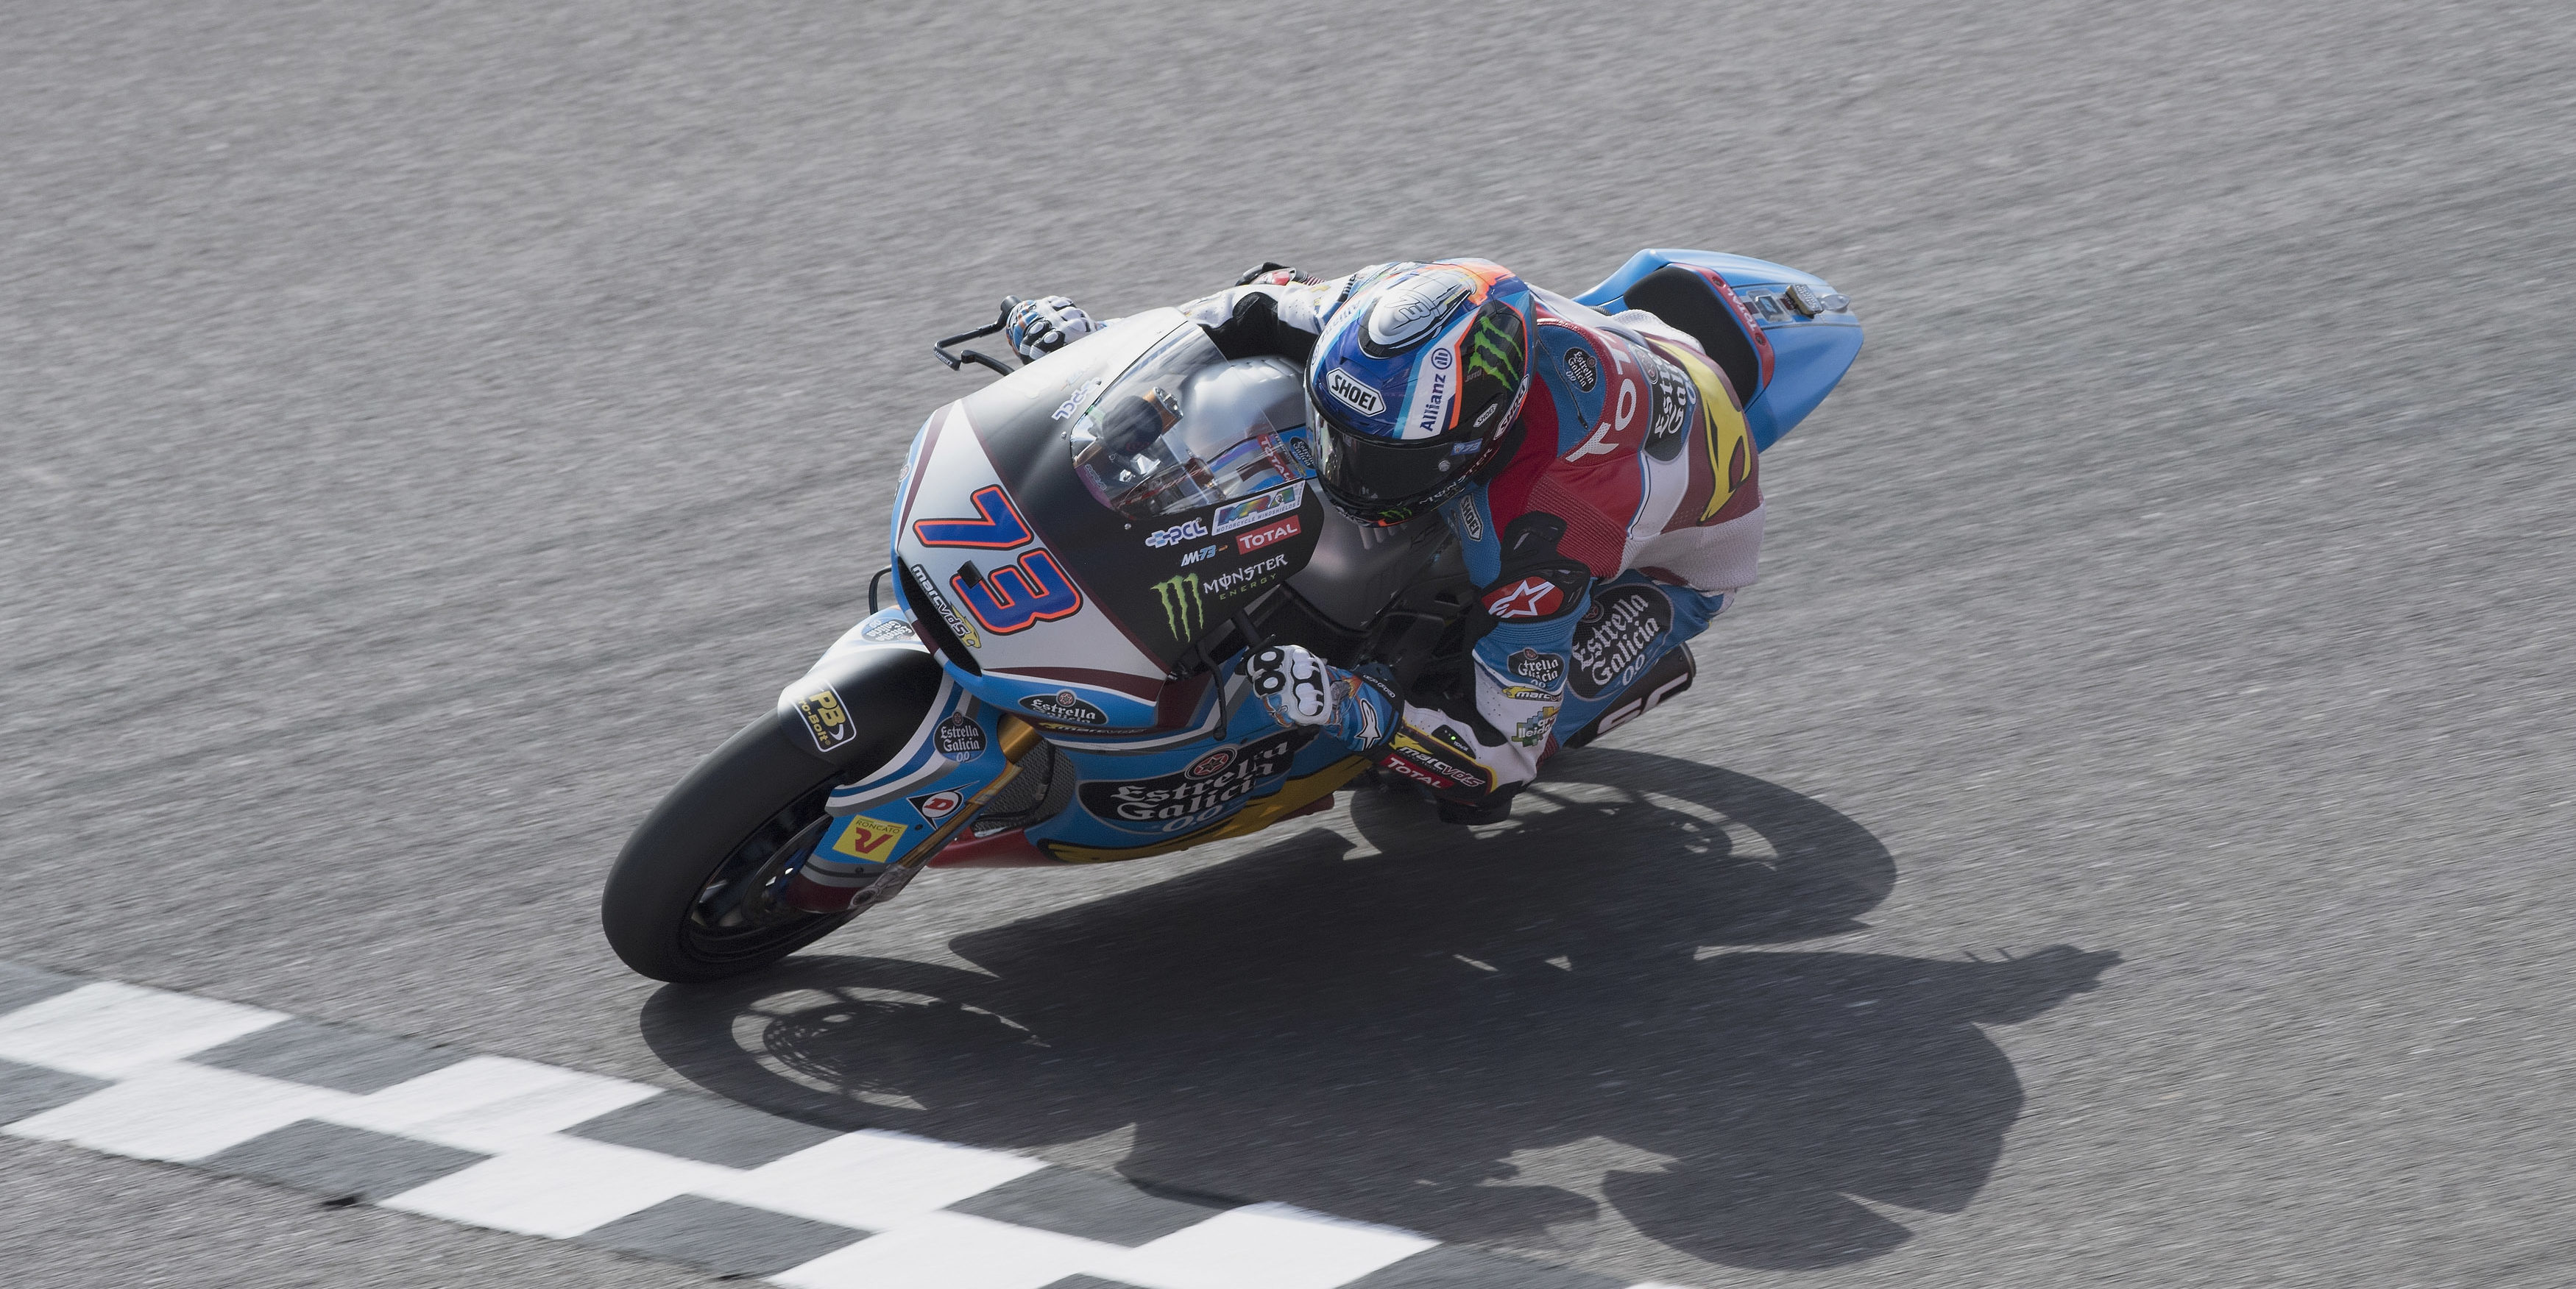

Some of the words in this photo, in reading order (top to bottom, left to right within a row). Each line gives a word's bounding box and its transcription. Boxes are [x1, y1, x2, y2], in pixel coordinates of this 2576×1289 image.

[1727, 288, 1755, 331] TOTAL
[1568, 358, 1587, 388] Galicia
[1574, 351, 1593, 384] Estrella
[1331, 373, 1377, 413] SHOEI
[1420, 373, 1446, 432] Allianz
[1500, 384, 1525, 432] SHOEI
[1476, 406, 1495, 425] SHOEI
[1216, 517, 1256, 533] MOTORCYCLE
[1257, 503, 1297, 520] WINDSHIELDS
[1217, 486, 1297, 527] MRA
[1461, 497, 1481, 537] SHOEI
[1239, 524, 1298, 549] TOTAL
[913, 484, 1083, 636] 73
[1203, 553, 1288, 594] MONSTER
[1220, 573, 1277, 600] ENERGY
[1572, 594, 1649, 672] Estrella
[1523, 658, 1559, 672] trella
[1592, 618, 1660, 686] Galicia
[797, 696, 829, 742] ro-Bolt
[809, 690, 846, 727] PB
[1031, 699, 1096, 720] Estrella
[940, 725, 979, 740] Estrella
[943, 738, 980, 752] Galicia
[1387, 757, 1442, 789] TOTAL
[855, 819, 900, 834] RONCATO
